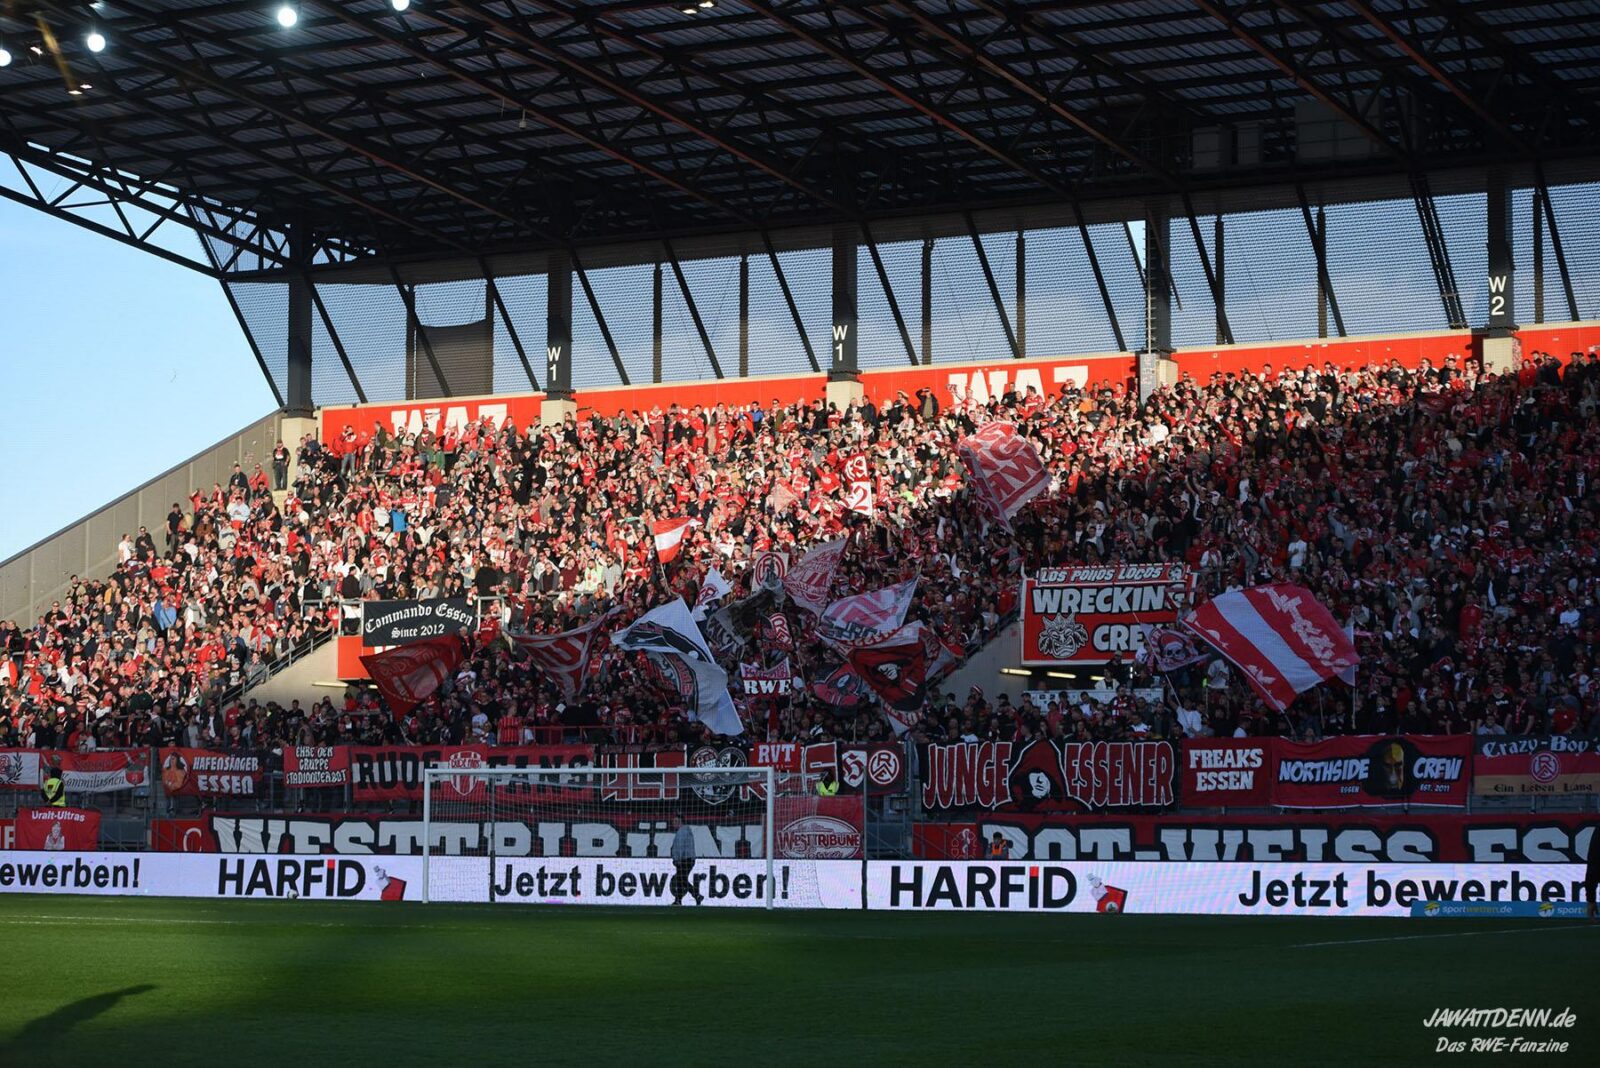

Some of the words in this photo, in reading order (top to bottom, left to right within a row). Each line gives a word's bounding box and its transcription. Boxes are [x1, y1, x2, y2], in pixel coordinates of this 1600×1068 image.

[1040, 570, 1067, 583] LOS
[1118, 566, 1163, 580] LOCOS
[365, 603, 432, 633] Commando
[435, 602, 474, 627] Essen
[391, 626, 418, 639] Since
[420, 623, 445, 636] 2012
[1093, 624, 1156, 651] CRE
[743, 679, 791, 695] RWE
[758, 743, 795, 764] RVT
[1189, 748, 1264, 769] FREAKS
[922, 741, 1013, 809] JUNGE
[1065, 741, 1175, 807] ESSENER
[1278, 758, 1371, 783] NORTHSIDE
[1412, 756, 1463, 780] CREW
[197, 775, 254, 794] ESSEN
[1195, 770, 1254, 791] ESSEN
[1493, 783, 1514, 793] Ein
[31, 810, 85, 822] Uralt-Ultras
[495, 864, 582, 897] Jetzt
[1238, 870, 1349, 908] Jetzt
